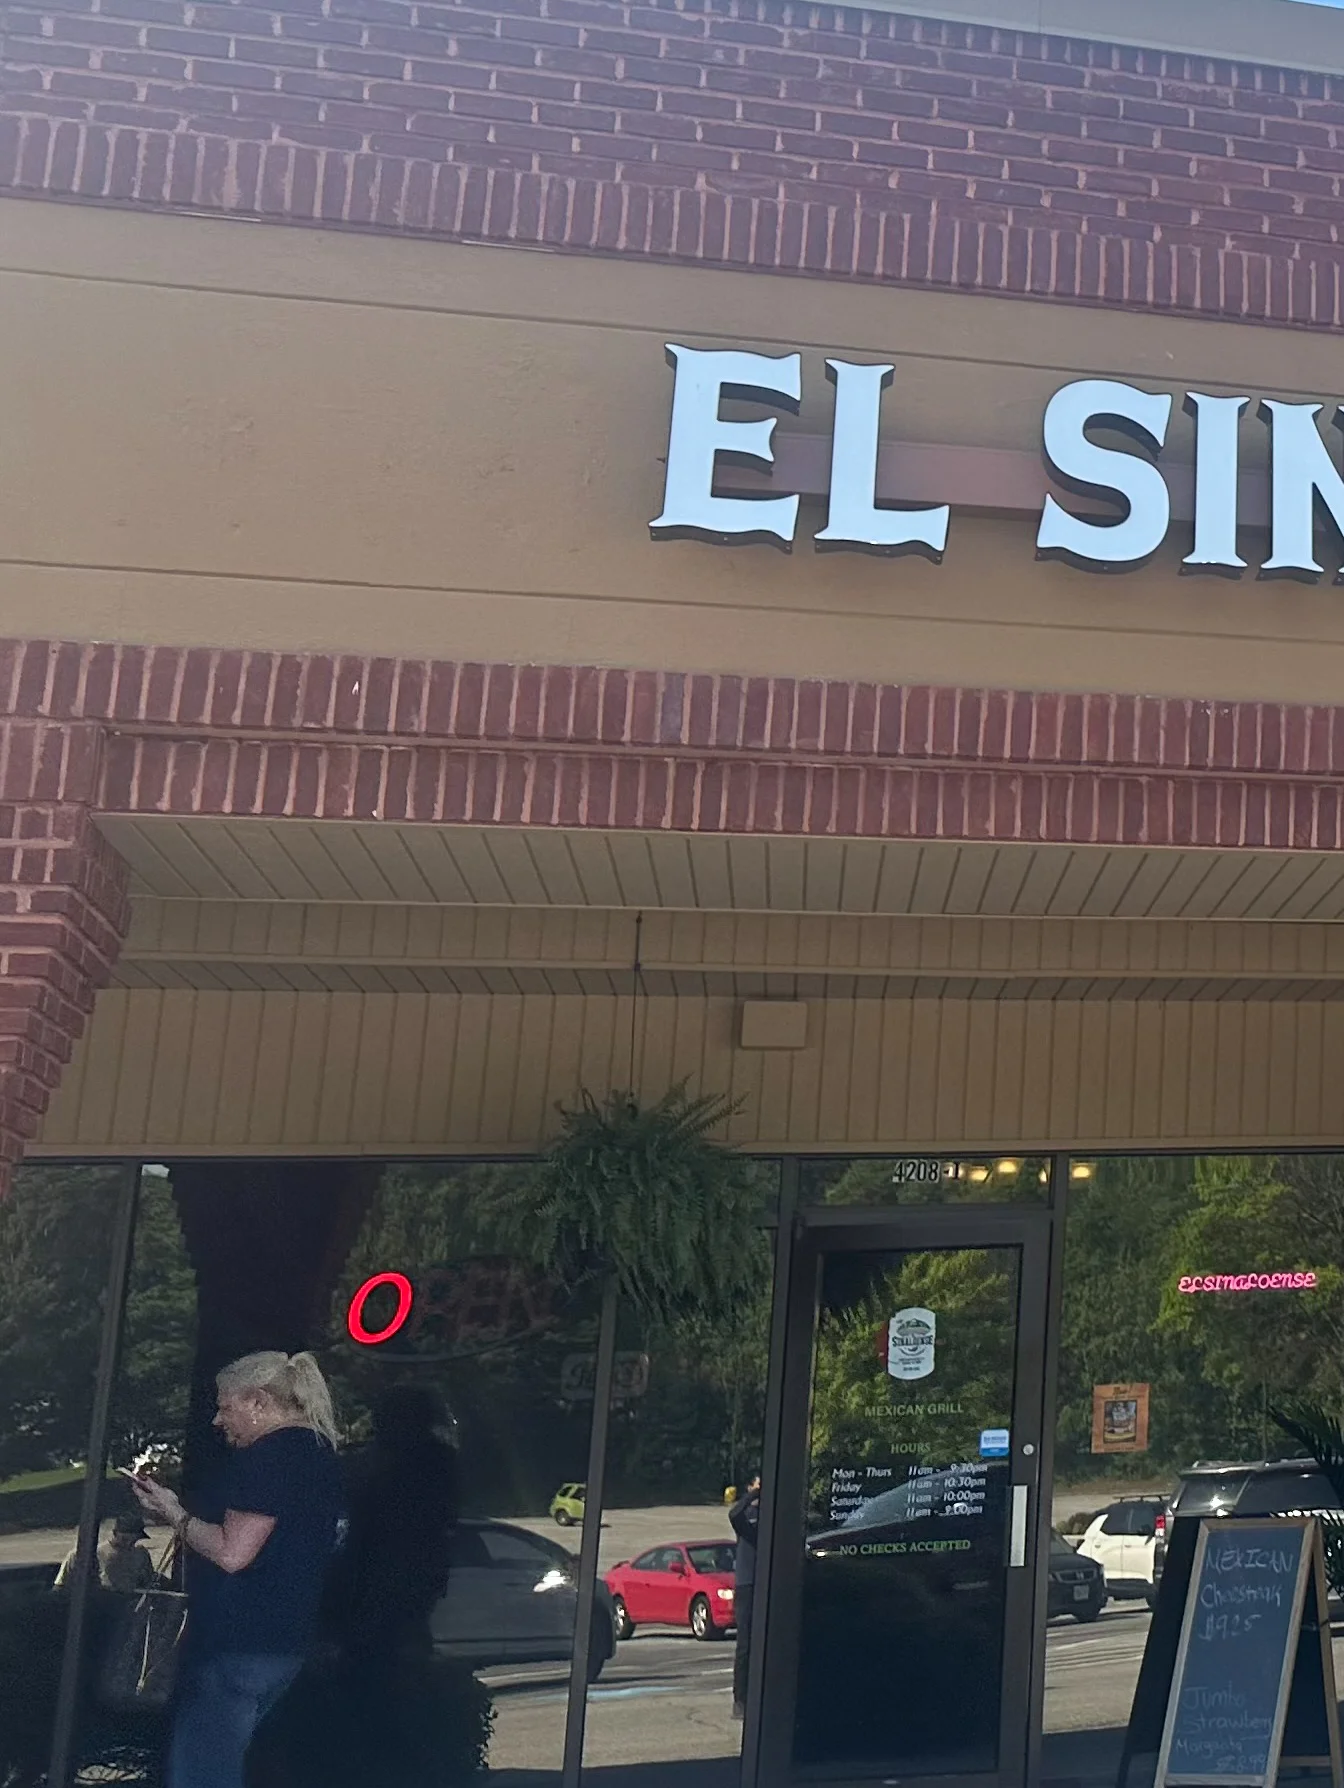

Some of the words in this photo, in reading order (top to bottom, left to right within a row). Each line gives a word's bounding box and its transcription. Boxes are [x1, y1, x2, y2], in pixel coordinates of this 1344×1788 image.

[648, 342, 951, 562] EL
[864, 1403, 924, 1417] MEXICAN
[927, 1402, 964, 1415] GRILL
[891, 1442, 931, 1454] HOURS
[831, 1468, 855, 1479] Mon
[866, 1466, 892, 1477] Thurs
[831, 1482, 862, 1493] Friday
[840, 1545, 857, 1556] NO
[860, 1543, 907, 1555] CHECKS
[910, 1540, 971, 1552] ACCEPTED
[1205, 1548, 1293, 1575] MEXICAN
